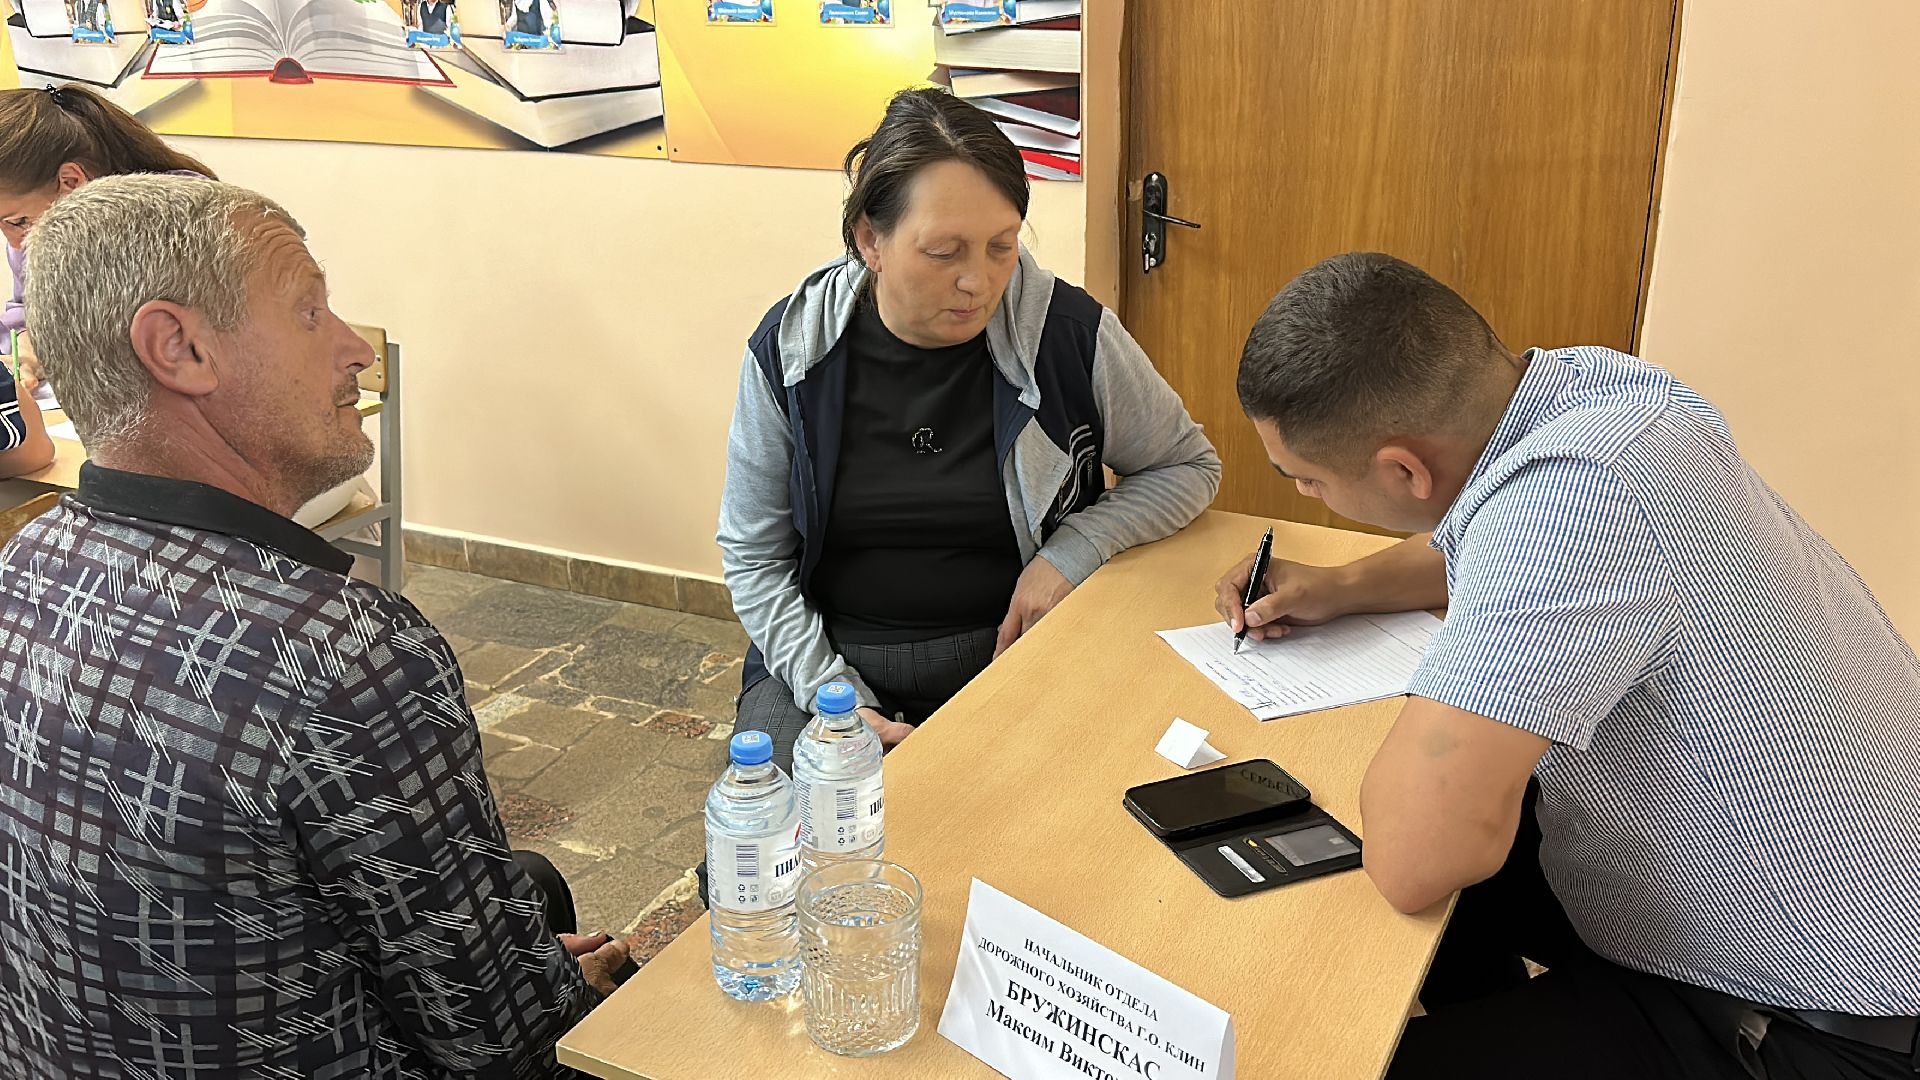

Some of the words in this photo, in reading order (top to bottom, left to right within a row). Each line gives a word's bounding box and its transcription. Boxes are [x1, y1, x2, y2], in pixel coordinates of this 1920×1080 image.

[978, 936, 1056, 987] ДОРОЖНОГО
[1057, 981, 1134, 1034] ХОЗЯЙСТВА
[1136, 1023, 1162, 1050] Г.О.
[1164, 1041, 1206, 1073] КЛИН
[1023, 937, 1103, 991] НАЧАЛЬНИК
[1104, 982, 1159, 1022] ОТДЕЛА
[985, 998, 1056, 1055] Максим
[1058, 1041, 1119, 1080] Викто
[1005, 978, 1162, 1080] БРУЖИНСКАС
